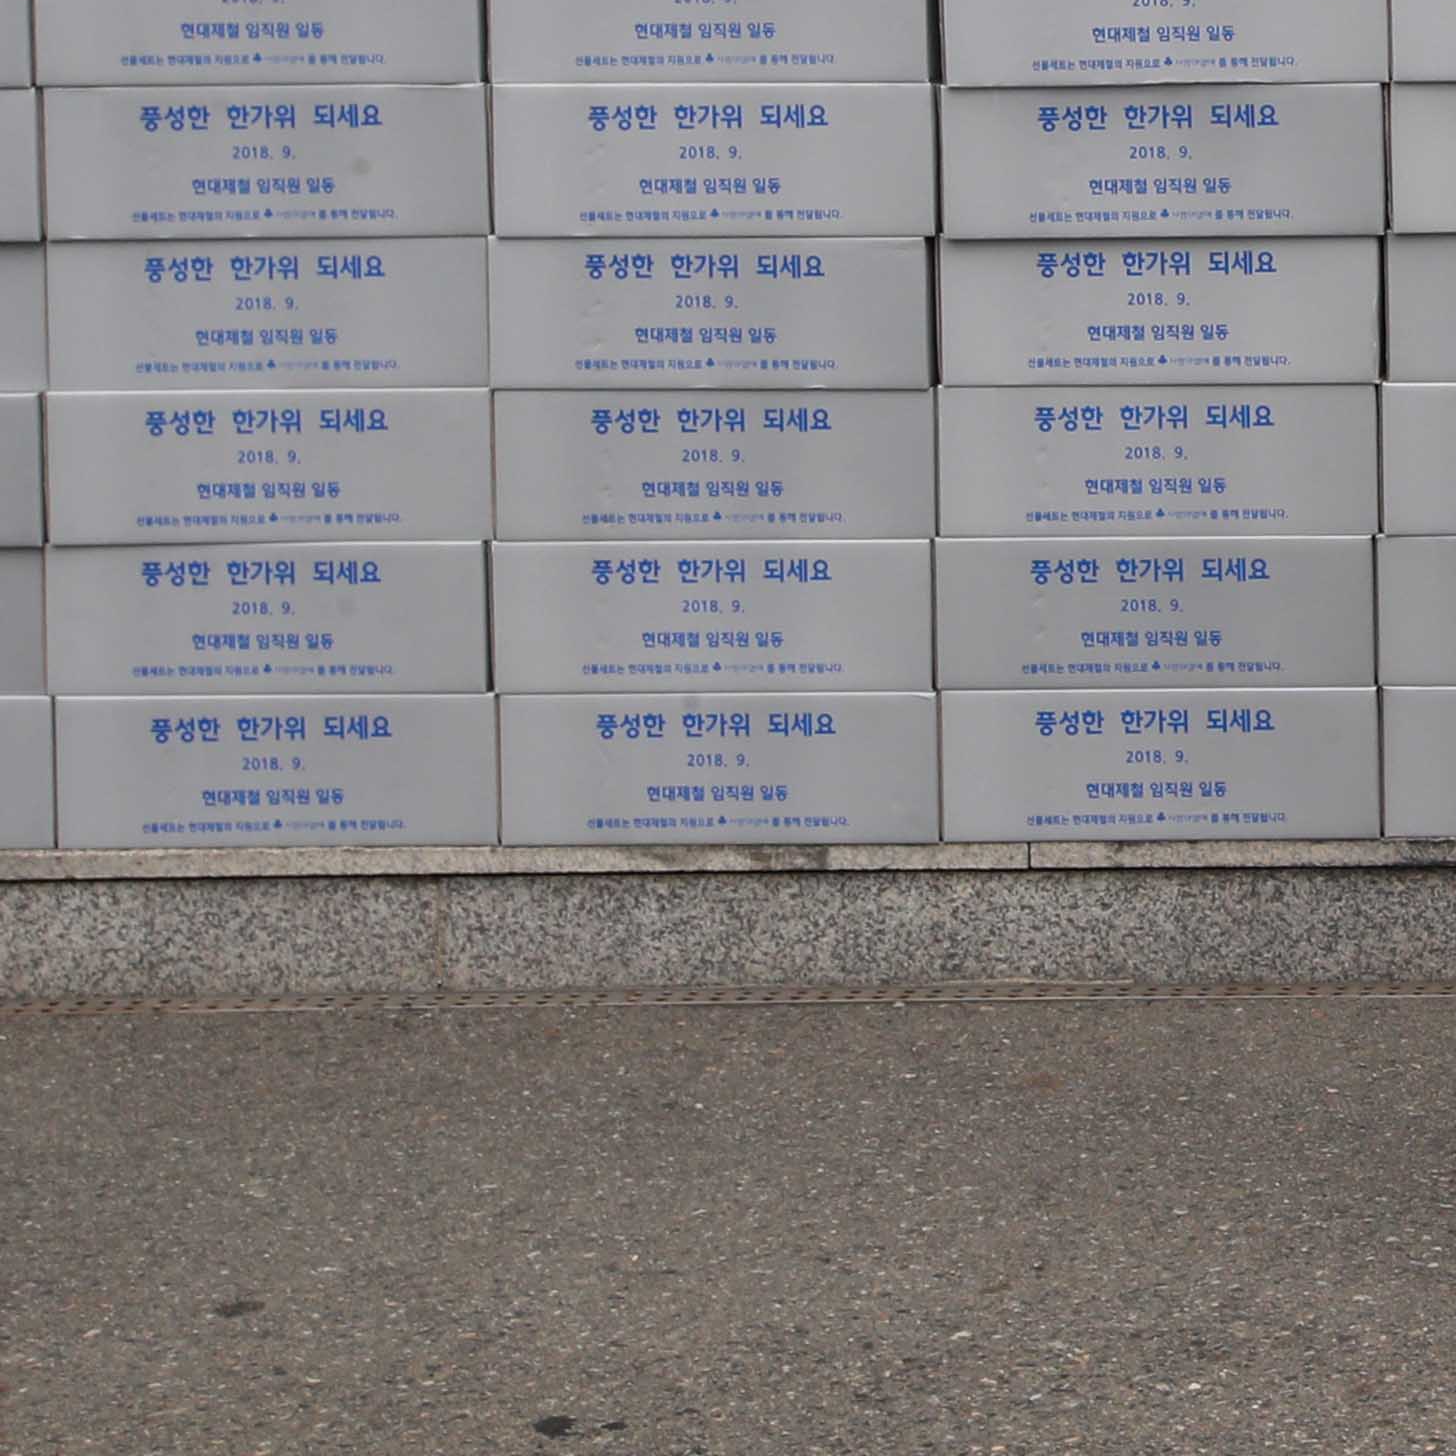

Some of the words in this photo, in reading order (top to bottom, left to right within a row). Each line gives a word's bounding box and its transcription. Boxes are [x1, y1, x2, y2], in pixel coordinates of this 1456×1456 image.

[1092, 27, 1152, 44] 현대제철
[1157, 25, 1201, 43] 임직원
[1207, 24, 1235, 42] 일동
[144, 409, 216, 436] 풍성한
[232, 407, 302, 435] 한가위
[319, 406, 389, 433] 되세요
[197, 483, 256, 500] 현대제철
[262, 481, 305, 499] 임직원
[312, 481, 340, 498] 일동
[1030, 558, 1100, 584] 풍성한
[1116, 556, 1185, 584] 한가위
[1201, 556, 1270, 582] 되세요
[1081, 631, 1140, 648] 현대제철
[1145, 630, 1188, 647] 임직원
[1194, 629, 1223, 646] 일동
[595, 713, 666, 739] 풍성한
[681, 711, 751, 738] 한가위
[767, 710, 837, 737] 되세요
[647, 786, 706, 802] 현대제철
[711, 785, 754, 802] 임직원
[760, 784, 789, 801] 일동
